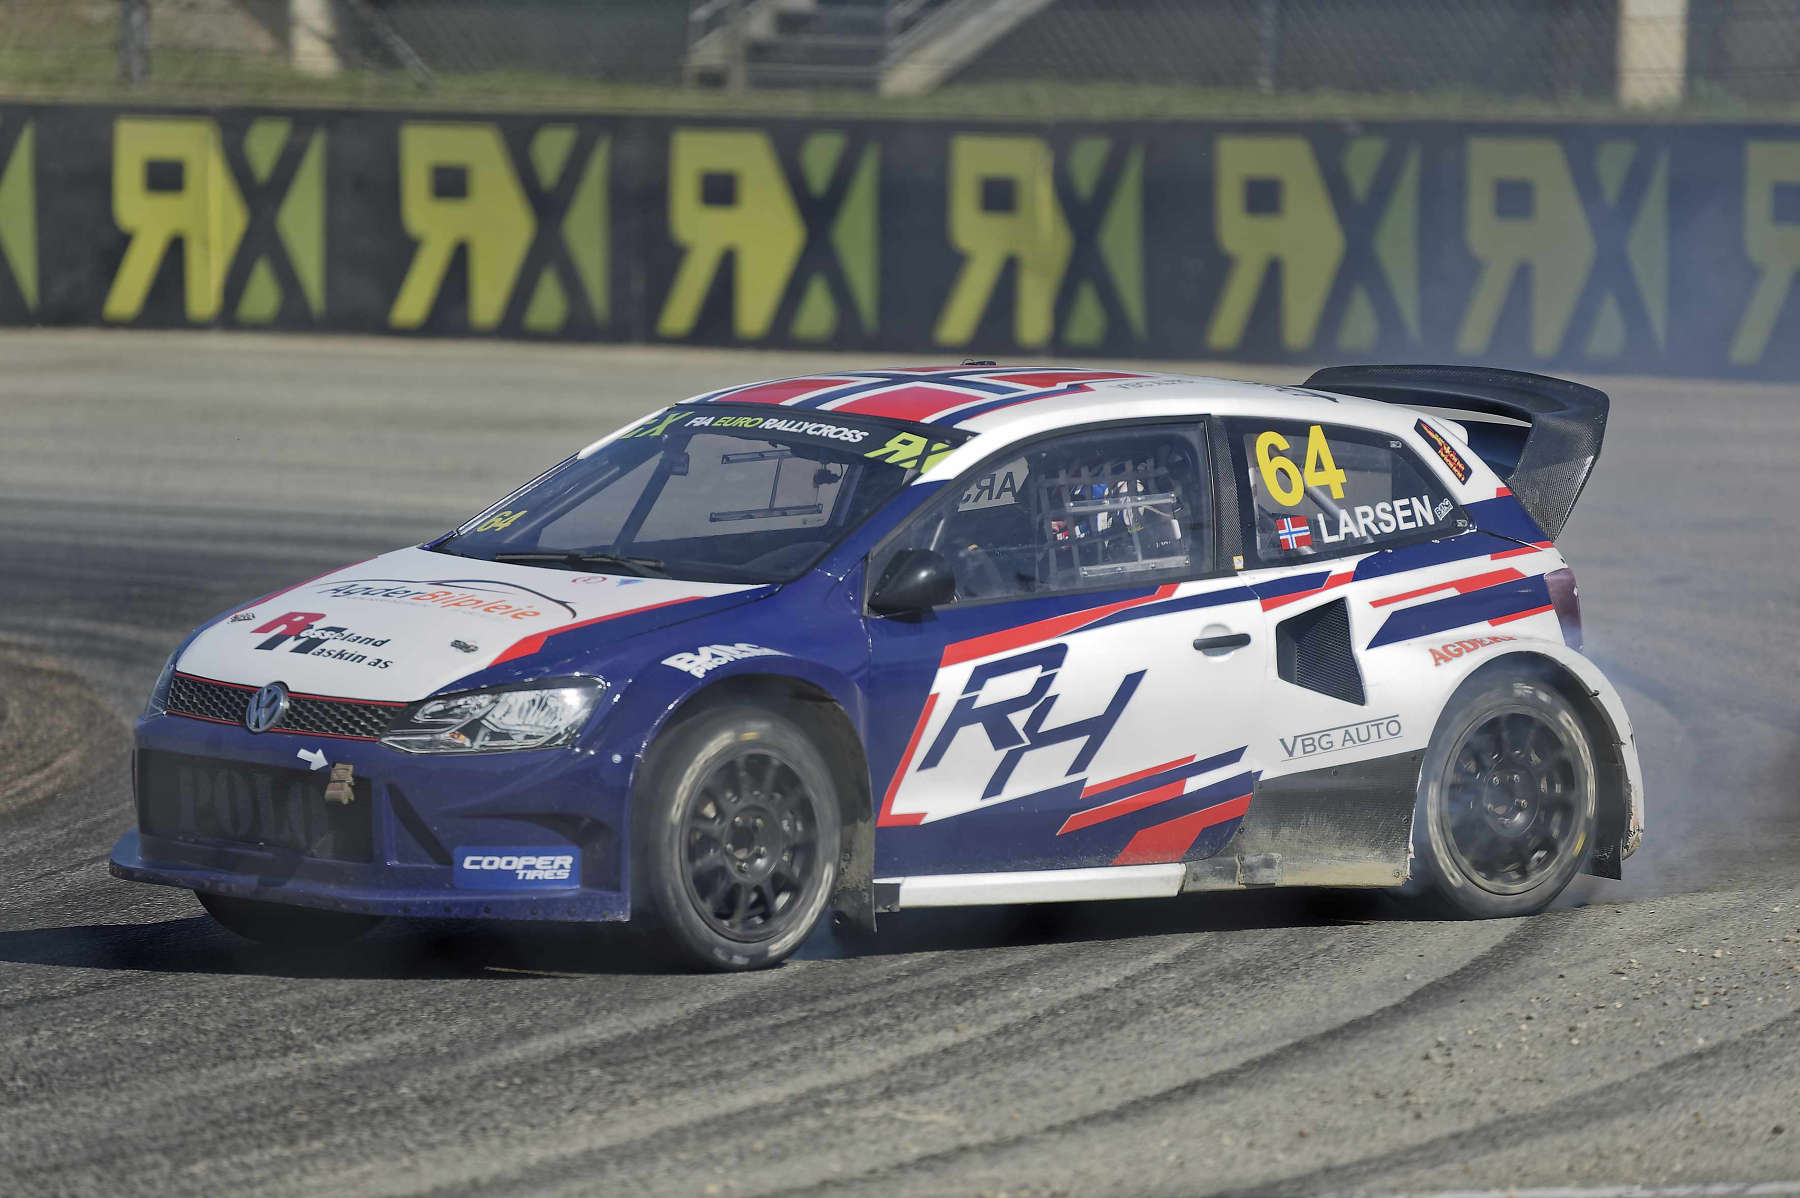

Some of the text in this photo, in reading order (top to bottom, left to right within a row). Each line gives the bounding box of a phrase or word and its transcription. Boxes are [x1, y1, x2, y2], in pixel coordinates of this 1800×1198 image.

[684, 416, 870, 443] FIA EURO RALLYCROSS
[1254, 424, 1348, 507] 64
[1317, 494, 1436, 544] LARSEN
[368, 658, 393, 670] as
[916, 642, 1149, 801] RH
[1279, 718, 1402, 758] VBG AUTO
[463, 855, 573, 870] COOPER
[515, 869, 571, 880] TIRES
